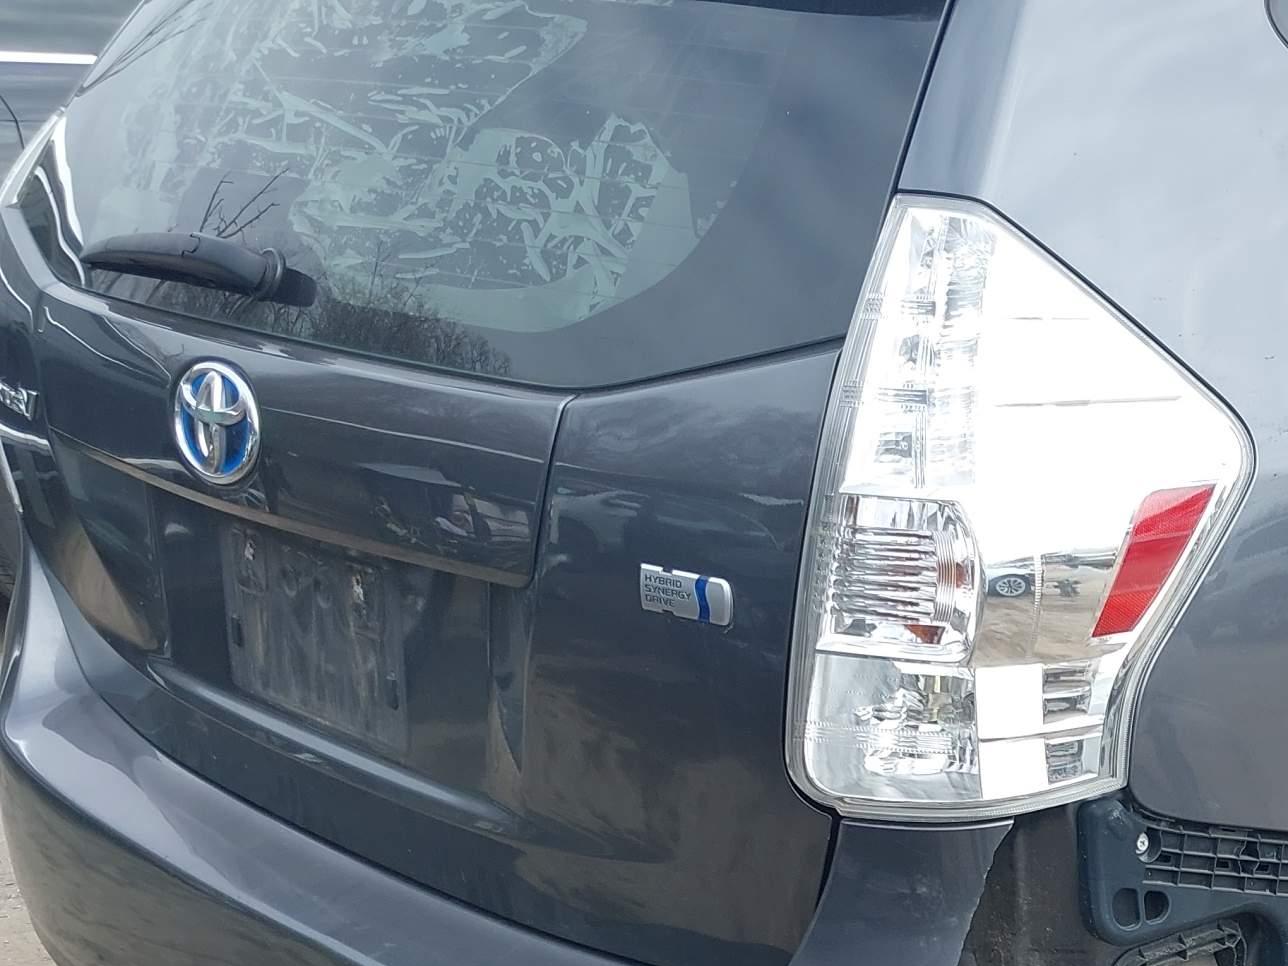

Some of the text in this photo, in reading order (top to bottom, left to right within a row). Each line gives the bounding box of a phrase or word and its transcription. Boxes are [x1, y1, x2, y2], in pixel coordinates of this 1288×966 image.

[645, 574, 682, 588] HYBRID
[645, 585, 691, 600] SYNERGY
[645, 594, 675, 607] DRIVE
